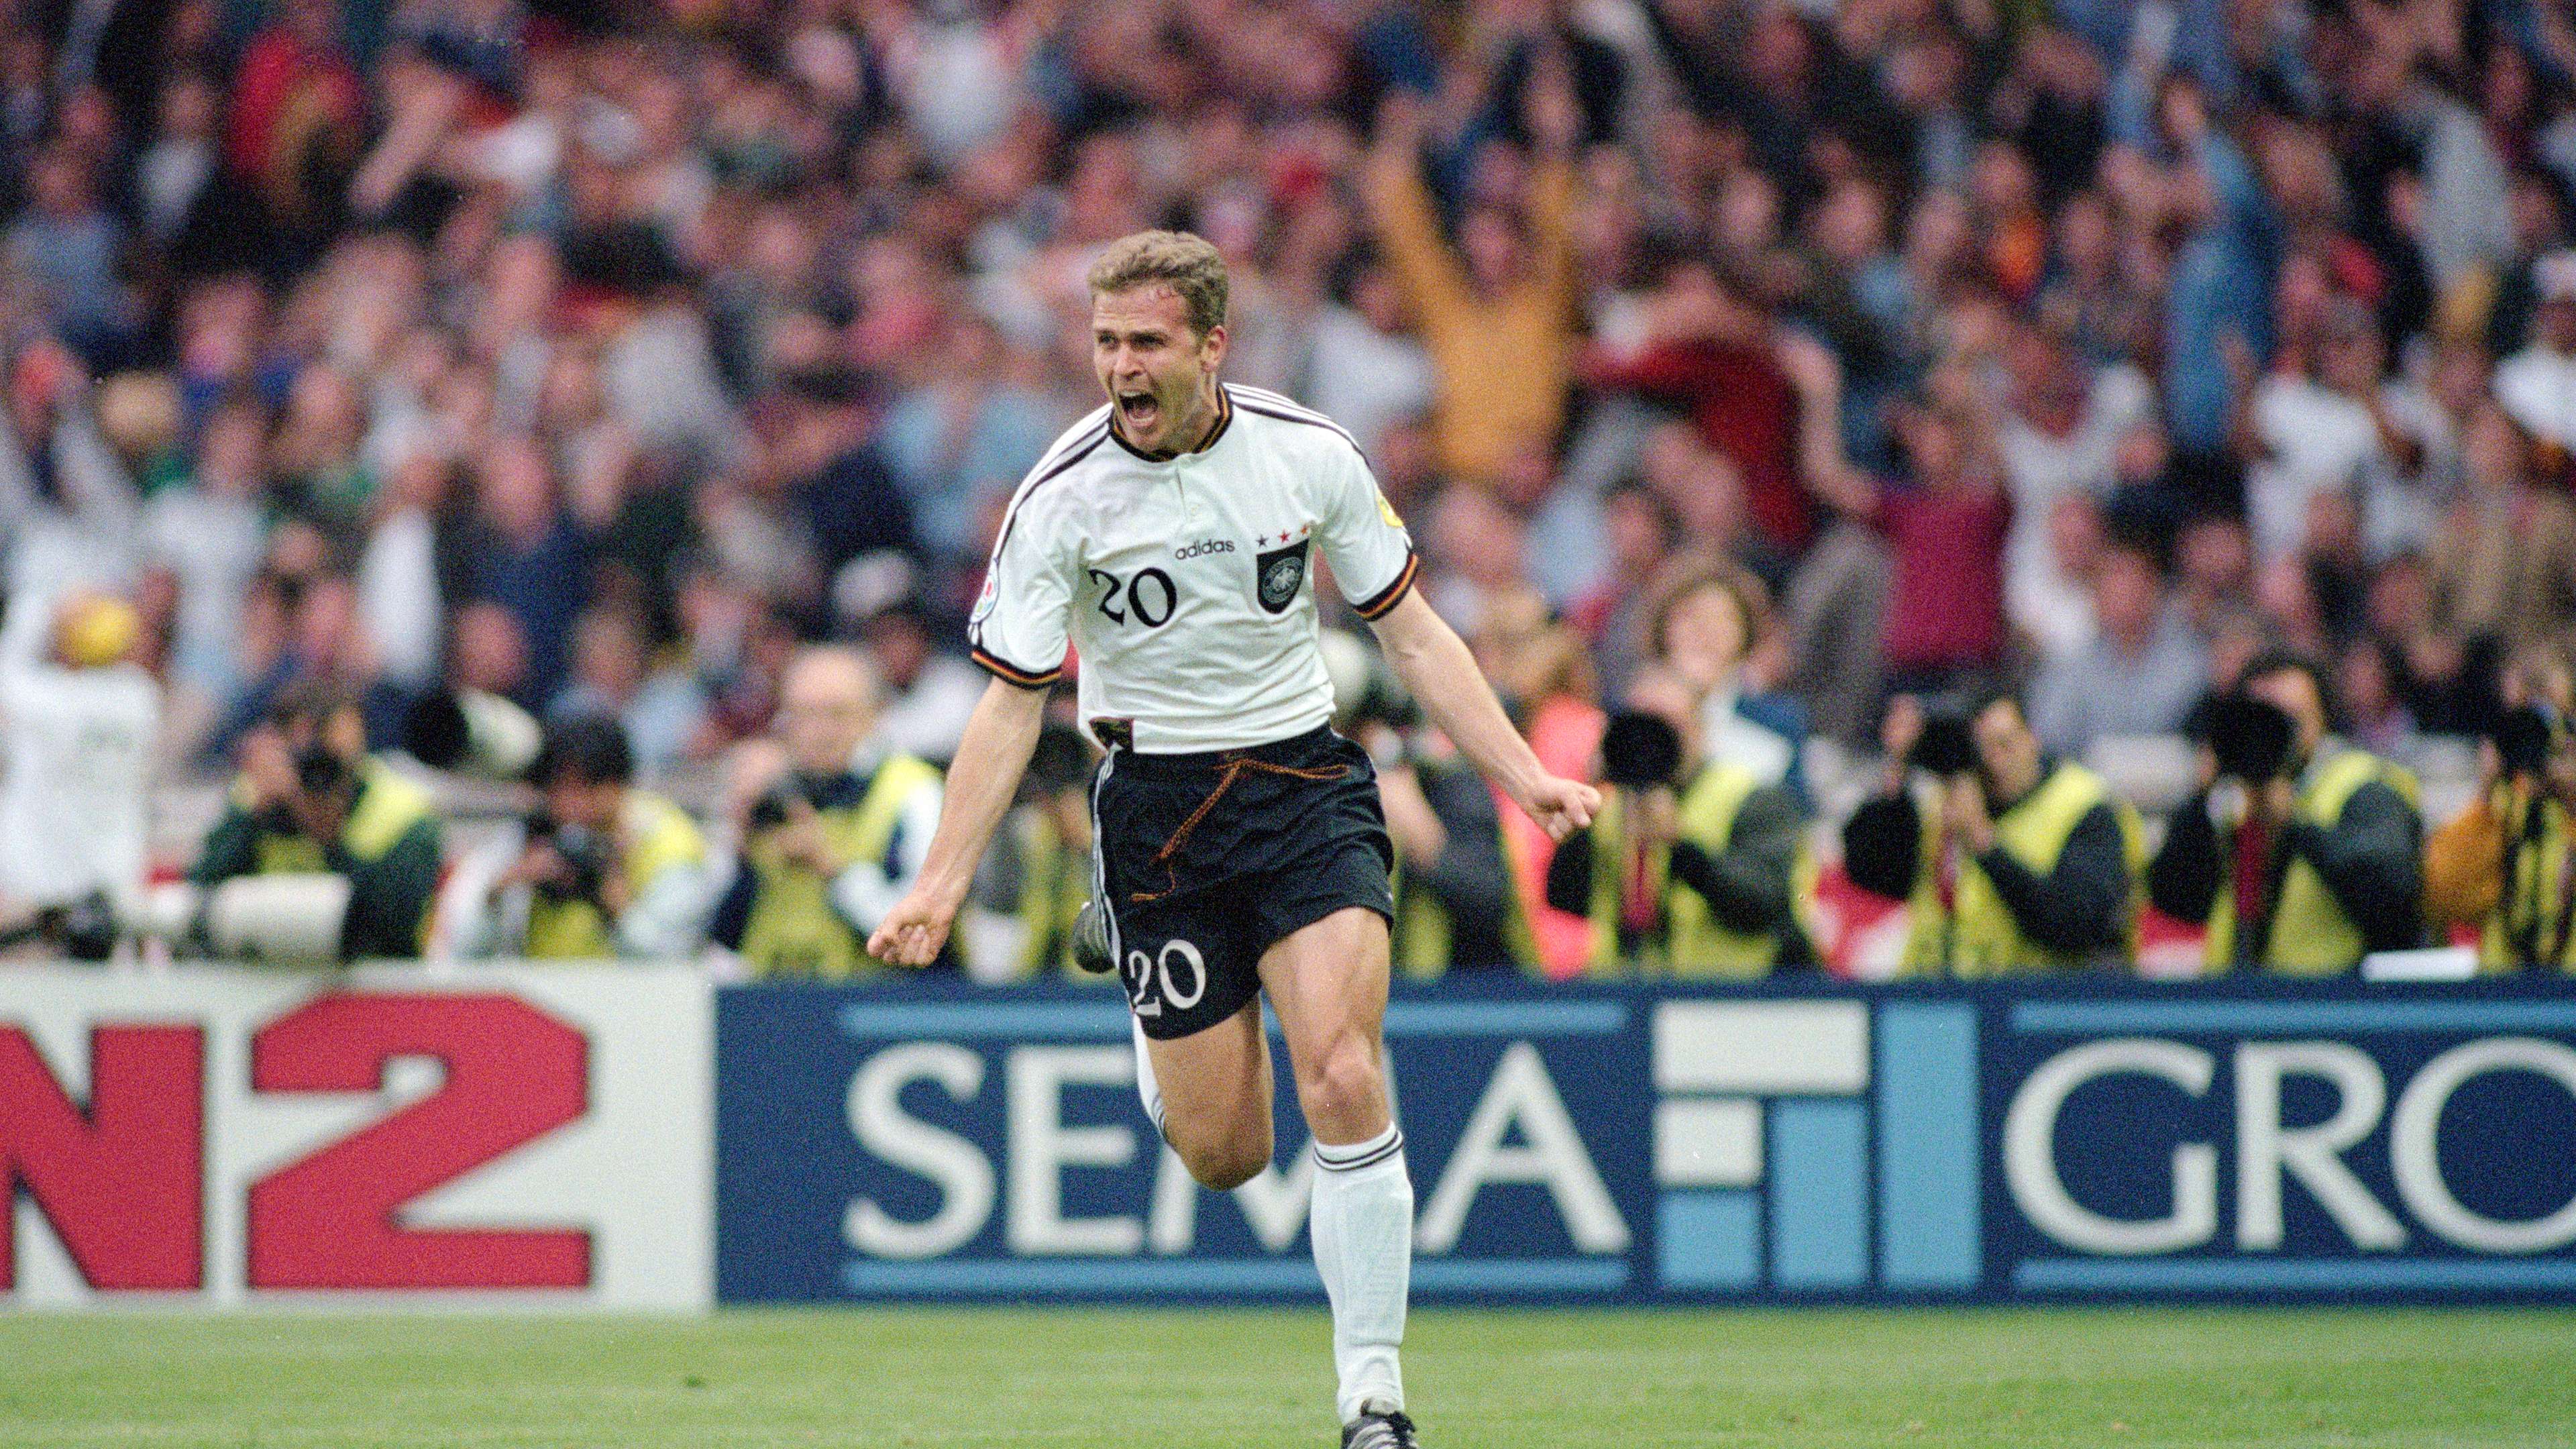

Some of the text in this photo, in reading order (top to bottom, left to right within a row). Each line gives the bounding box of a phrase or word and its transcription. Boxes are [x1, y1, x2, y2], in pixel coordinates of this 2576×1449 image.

[1175, 539, 1235, 560] adidas
[1088, 567, 1177, 629] 20
[1128, 939, 1206, 1017] 20
[2003, 1036, 2576, 1256] GRO
